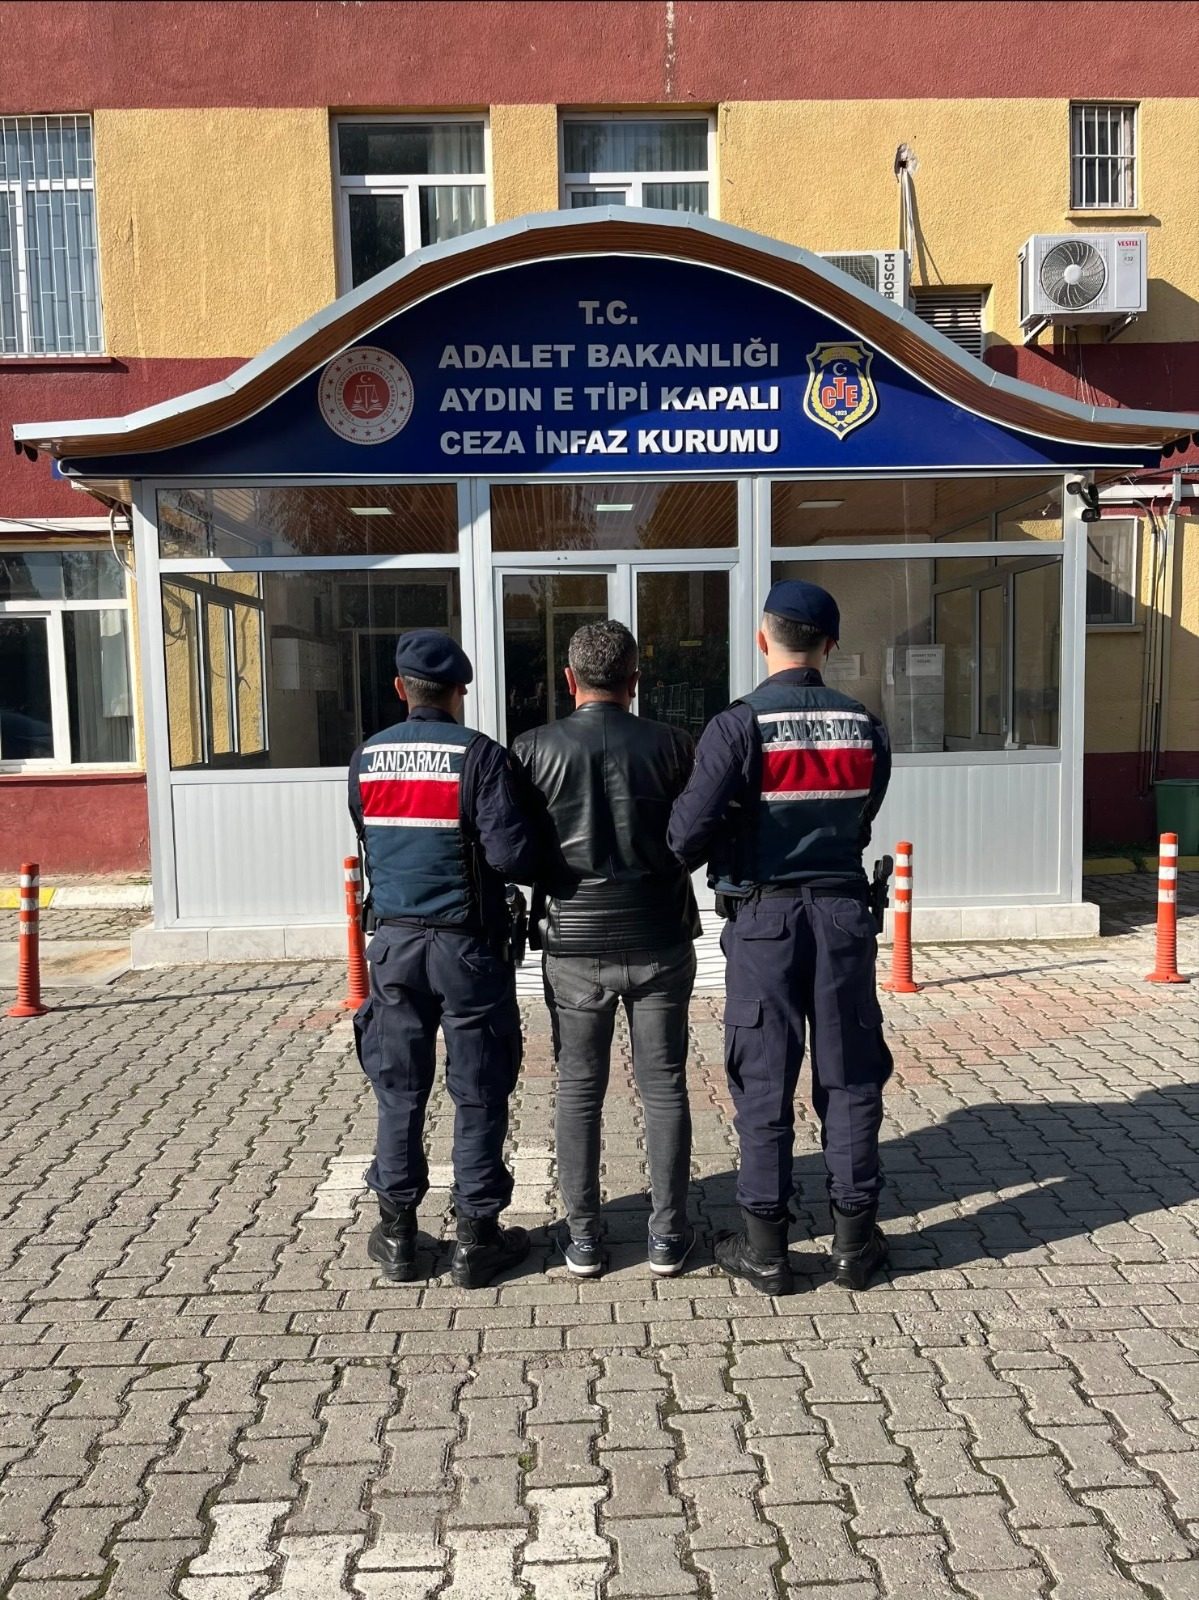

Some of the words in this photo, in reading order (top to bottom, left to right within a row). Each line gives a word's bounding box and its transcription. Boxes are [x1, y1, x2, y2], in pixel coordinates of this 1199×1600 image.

[884, 253, 895, 300] BOSCH
[578, 300, 638, 325] T.C.
[438, 344, 576, 369] ADALET
[587, 337, 779, 368] BAKANLIĞI
[439, 387, 542, 412] AYDIN
[554, 387, 574, 411] E
[584, 381, 649, 411] TİPİ
[660, 385, 780, 411] KAPALI
[821, 376, 858, 409] CTE
[439, 430, 526, 455] CEZA
[535, 425, 628, 454] İNFAZ
[638, 429, 779, 454] KURUMU
[772, 718, 863, 742] JANDARMA
[367, 750, 452, 773] JANDARMA
